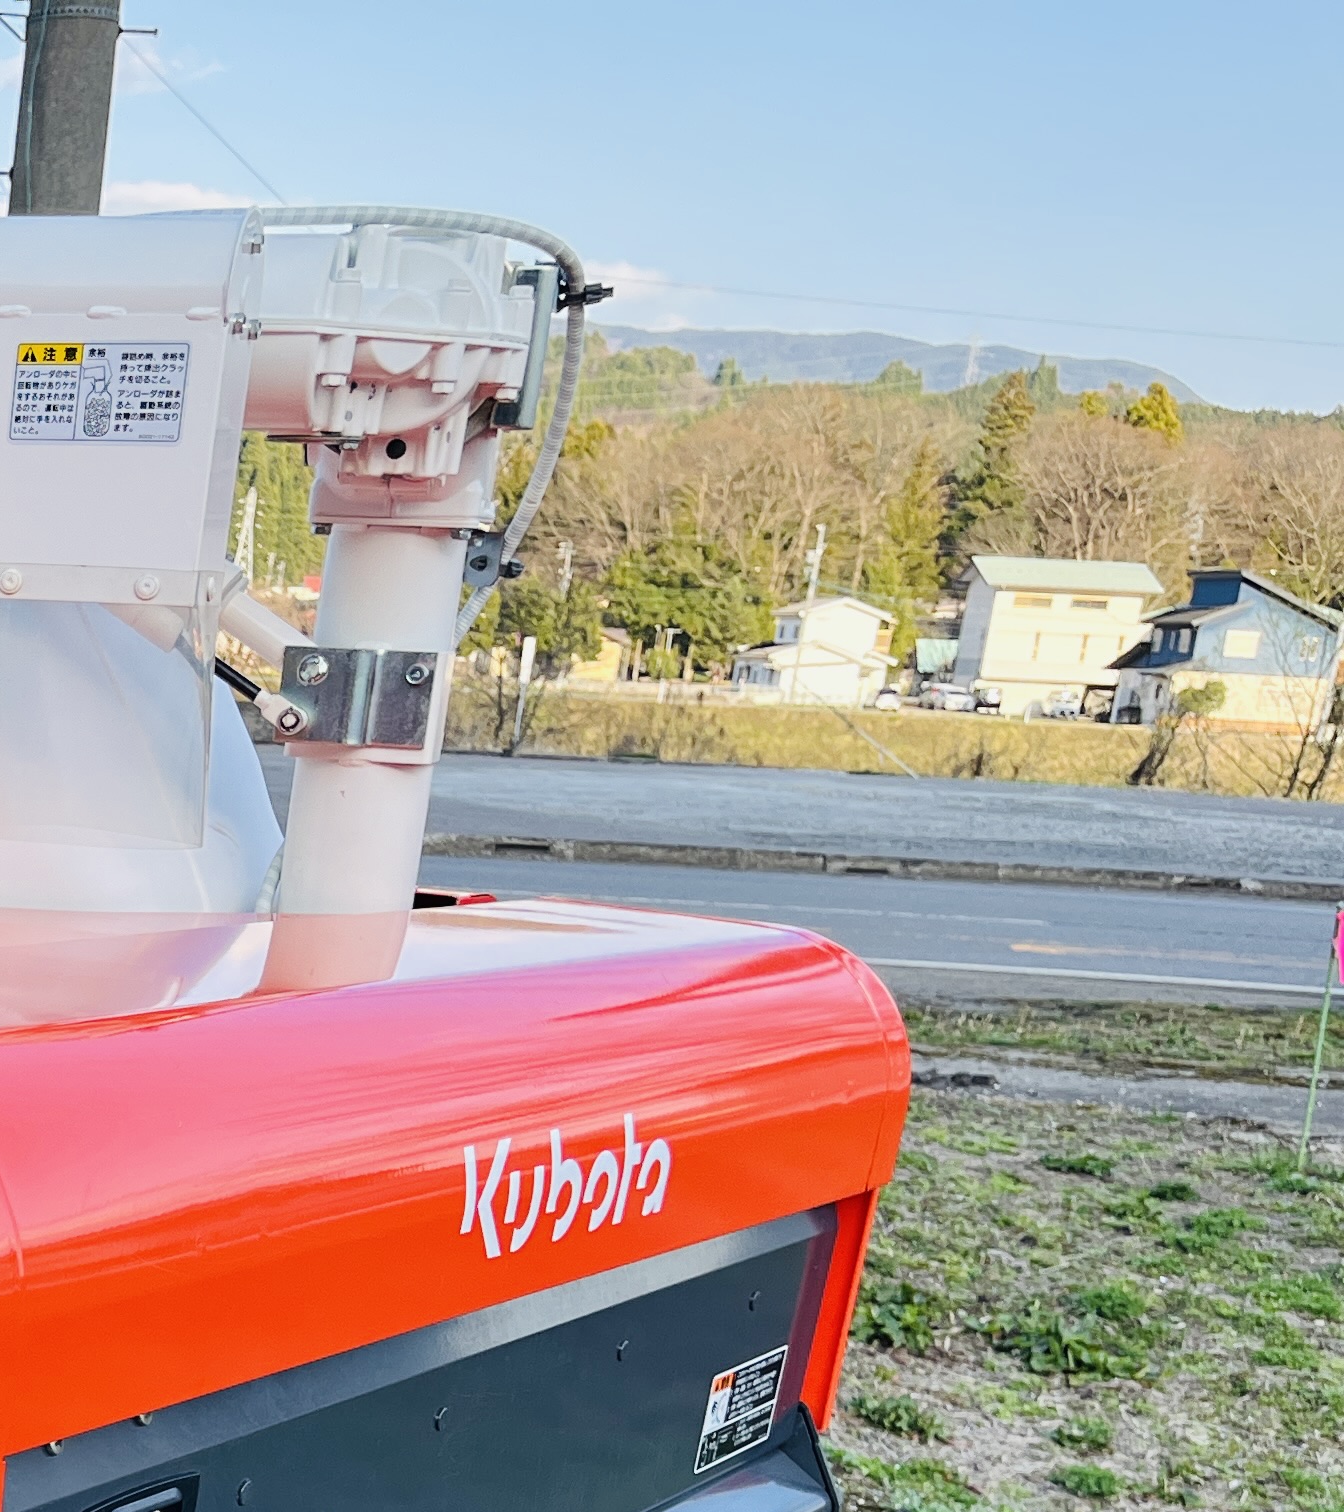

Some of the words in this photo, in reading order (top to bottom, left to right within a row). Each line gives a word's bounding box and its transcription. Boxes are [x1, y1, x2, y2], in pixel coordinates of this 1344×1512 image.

[43, 348, 77, 362] 注意
[19, 370, 77, 378] アンローダの中に
[460, 1113, 671, 1259] Kubota
